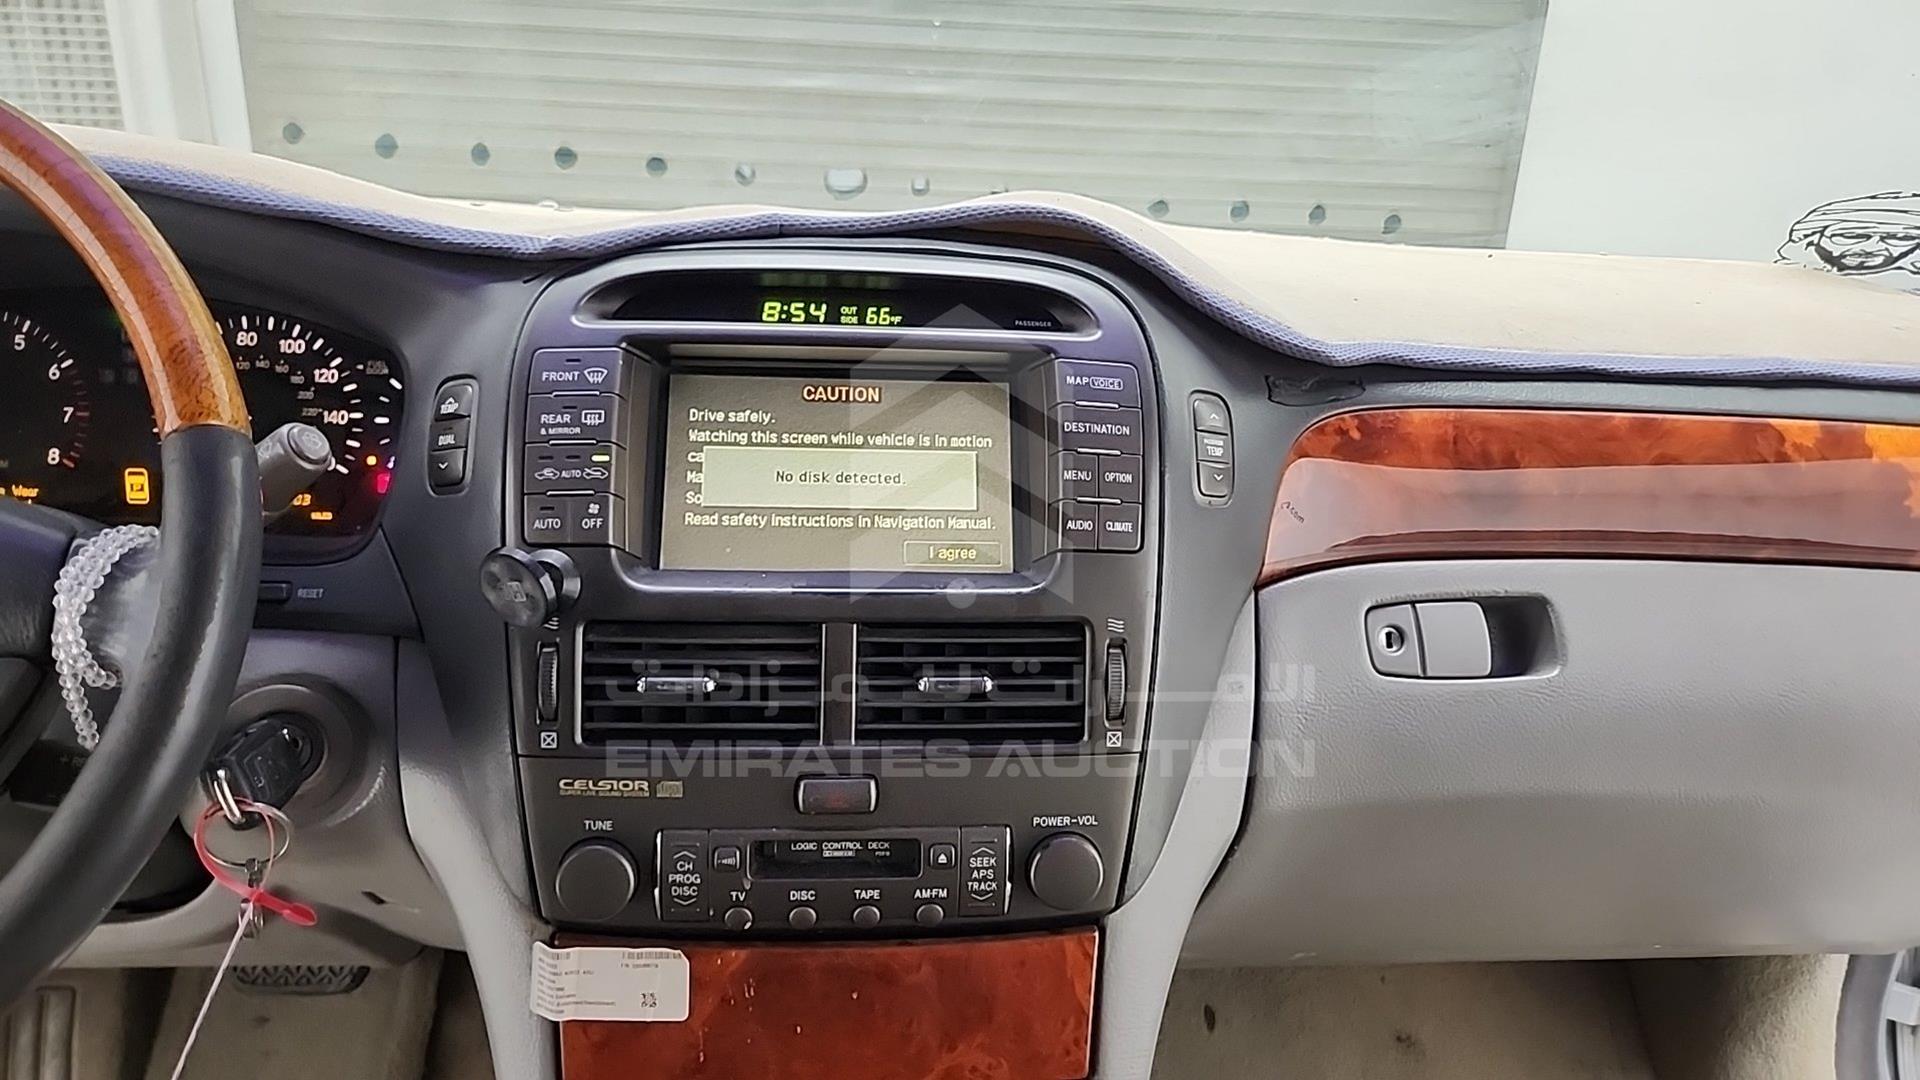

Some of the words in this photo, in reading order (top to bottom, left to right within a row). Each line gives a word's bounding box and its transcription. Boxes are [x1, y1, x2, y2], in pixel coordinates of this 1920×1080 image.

[762, 301, 827, 323] 8:54
[840, 306, 857, 315] OUT
[840, 316, 858, 324] SIDE
[1014, 319, 1052, 327] PASSENGER
[14, 334, 25, 350] 5
[236, 331, 258, 346] 80
[279, 339, 306, 354] 100
[48, 364, 60, 380] 6
[313, 368, 339, 383] 120
[541, 371, 580, 382] FRONT
[1066, 375, 1089, 386] MAP
[1092, 378, 1121, 388] VOICE
[802, 385, 880, 402] CAUTION
[63, 406, 74, 423] 7
[323, 410, 349, 425] 140
[540, 414, 571, 424] REAR
[688, 408, 725, 423] Drive
[728, 410, 776, 425] safely.
[549, 427, 581, 435] MIRROR
[1064, 421, 1130, 436] DESTINATION
[688, 428, 748, 444] Watching
[751, 430, 778, 444] this
[781, 433, 828, 445] screen
[831, 432, 864, 445] while
[867, 433, 915, 447] vehicle
[919, 433, 931, 447] is
[935, 434, 947, 447] in
[951, 435, 993, 448] motion
[47, 447, 60, 465] 8
[560, 470, 582, 479] AUTO
[776, 470, 794, 483] No
[799, 471, 830, 484] disk
[836, 472, 906, 486] detected.
[1064, 470, 1092, 482] MENU
[1104, 471, 1133, 484] OPTION
[533, 518, 562, 529] AUTO
[582, 518, 604, 529] OFF
[684, 511, 719, 526] Read
[721, 513, 768, 529] safety
[771, 513, 854, 528] instructions
[858, 514, 871, 528] in
[873, 515, 945, 531] Navigation
[947, 516, 996, 531] Manual.
[1066, 519, 1094, 531] AUDIO
[1105, 521, 1134, 533] CLIMATE
[929, 545, 935, 559] I
[938, 547, 977, 561] agree
[558, 779, 650, 791] CELSIOR
[584, 820, 613, 831] TUNE
[1033, 815, 1098, 827] POWER-VOL
[791, 842, 818, 850] LOGIC
[822, 841, 863, 850] CONTROL
[867, 841, 890, 850] DECK
[676, 860, 693, 871] CH
[969, 856, 997, 867] SEEK
[668, 873, 700, 885] PROG
[971, 869, 995, 880] APS
[671, 885, 698, 897] DISC
[967, 881, 998, 892] TRACK
[730, 891, 746, 901] TV
[790, 889, 816, 901] DISC
[854, 889, 880, 900] TAPE
